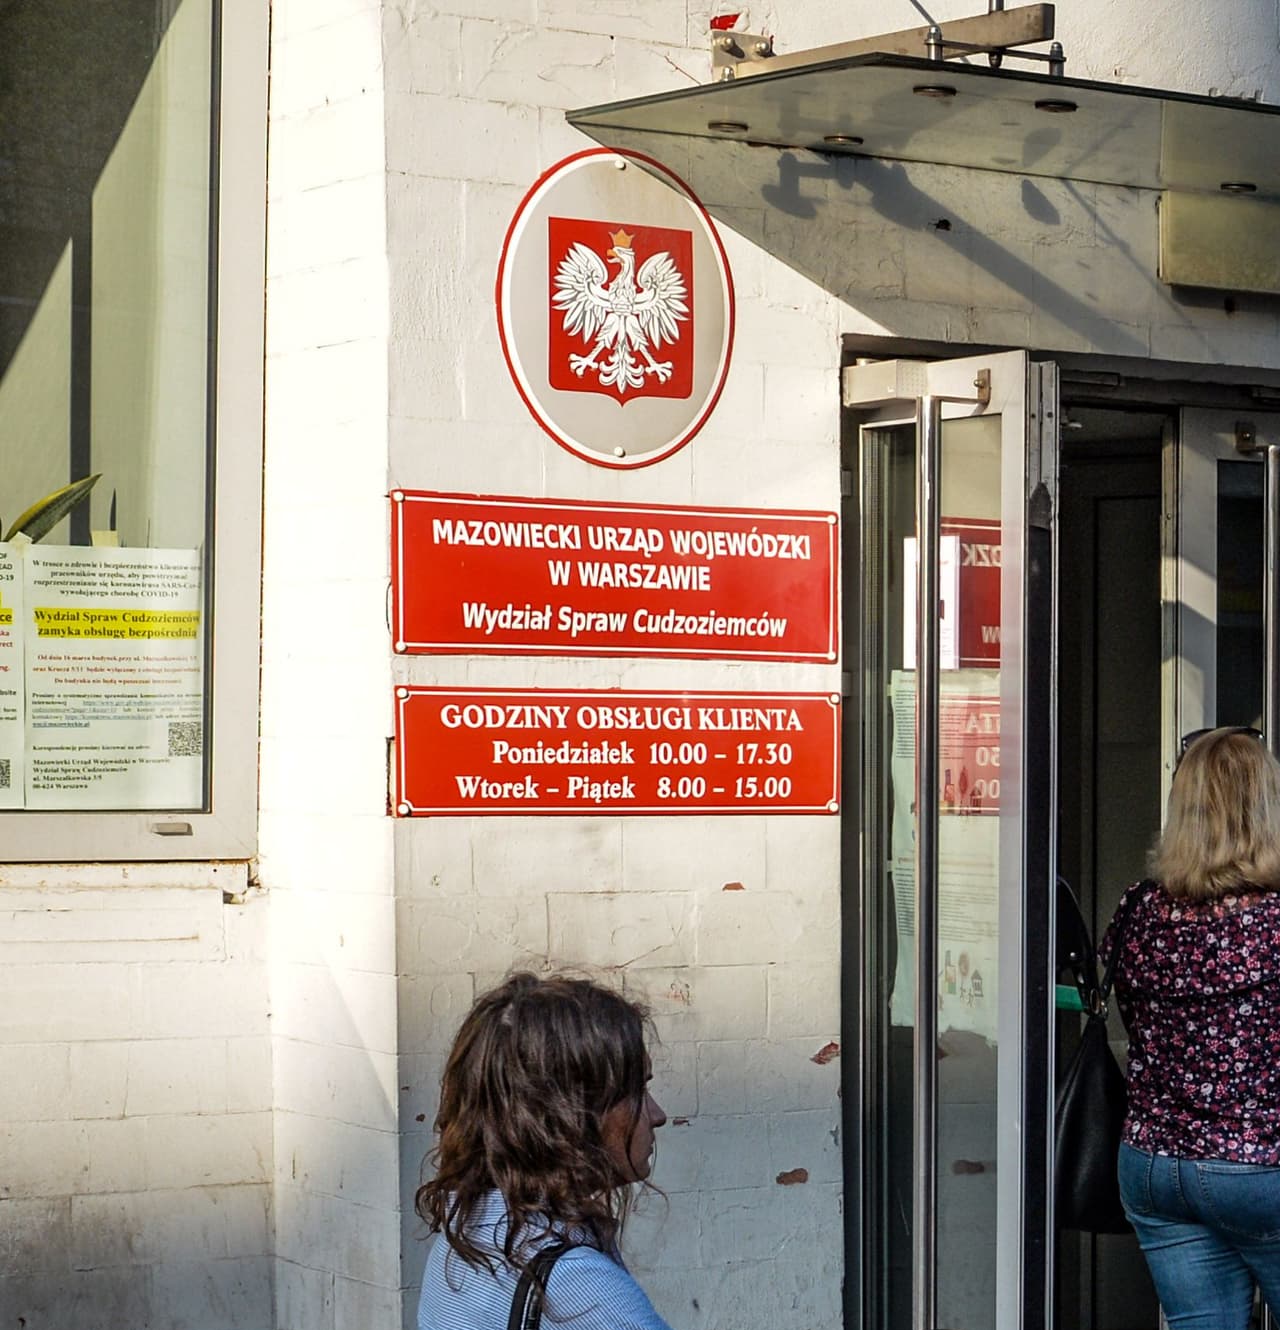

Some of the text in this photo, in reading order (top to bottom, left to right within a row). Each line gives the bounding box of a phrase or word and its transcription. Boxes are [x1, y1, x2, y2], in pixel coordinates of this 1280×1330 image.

[432, 519, 811, 560] MAZOWIECKI URZĄD WOJEWÓDZKI
[548, 560, 711, 591] W WARSZAWIE
[83, 611, 118, 624] Spraw
[122, 612, 200, 624] Cudzoziemców
[462, 602, 788, 638] Wydział Spraw Cudzoziemców
[38, 626, 80, 638] zamyka
[440, 704, 804, 731] GODZINY OBSŁUGI KLIENTA
[492, 740, 635, 764] Poniedziałek
[649, 742, 707, 764] 10.00
[736, 743, 792, 764] 17.30
[455, 775, 540, 799] Wtorek
[567, 775, 636, 803] Piątek
[656, 776, 707, 798] 8.00
[735, 776, 792, 798] 15.00
